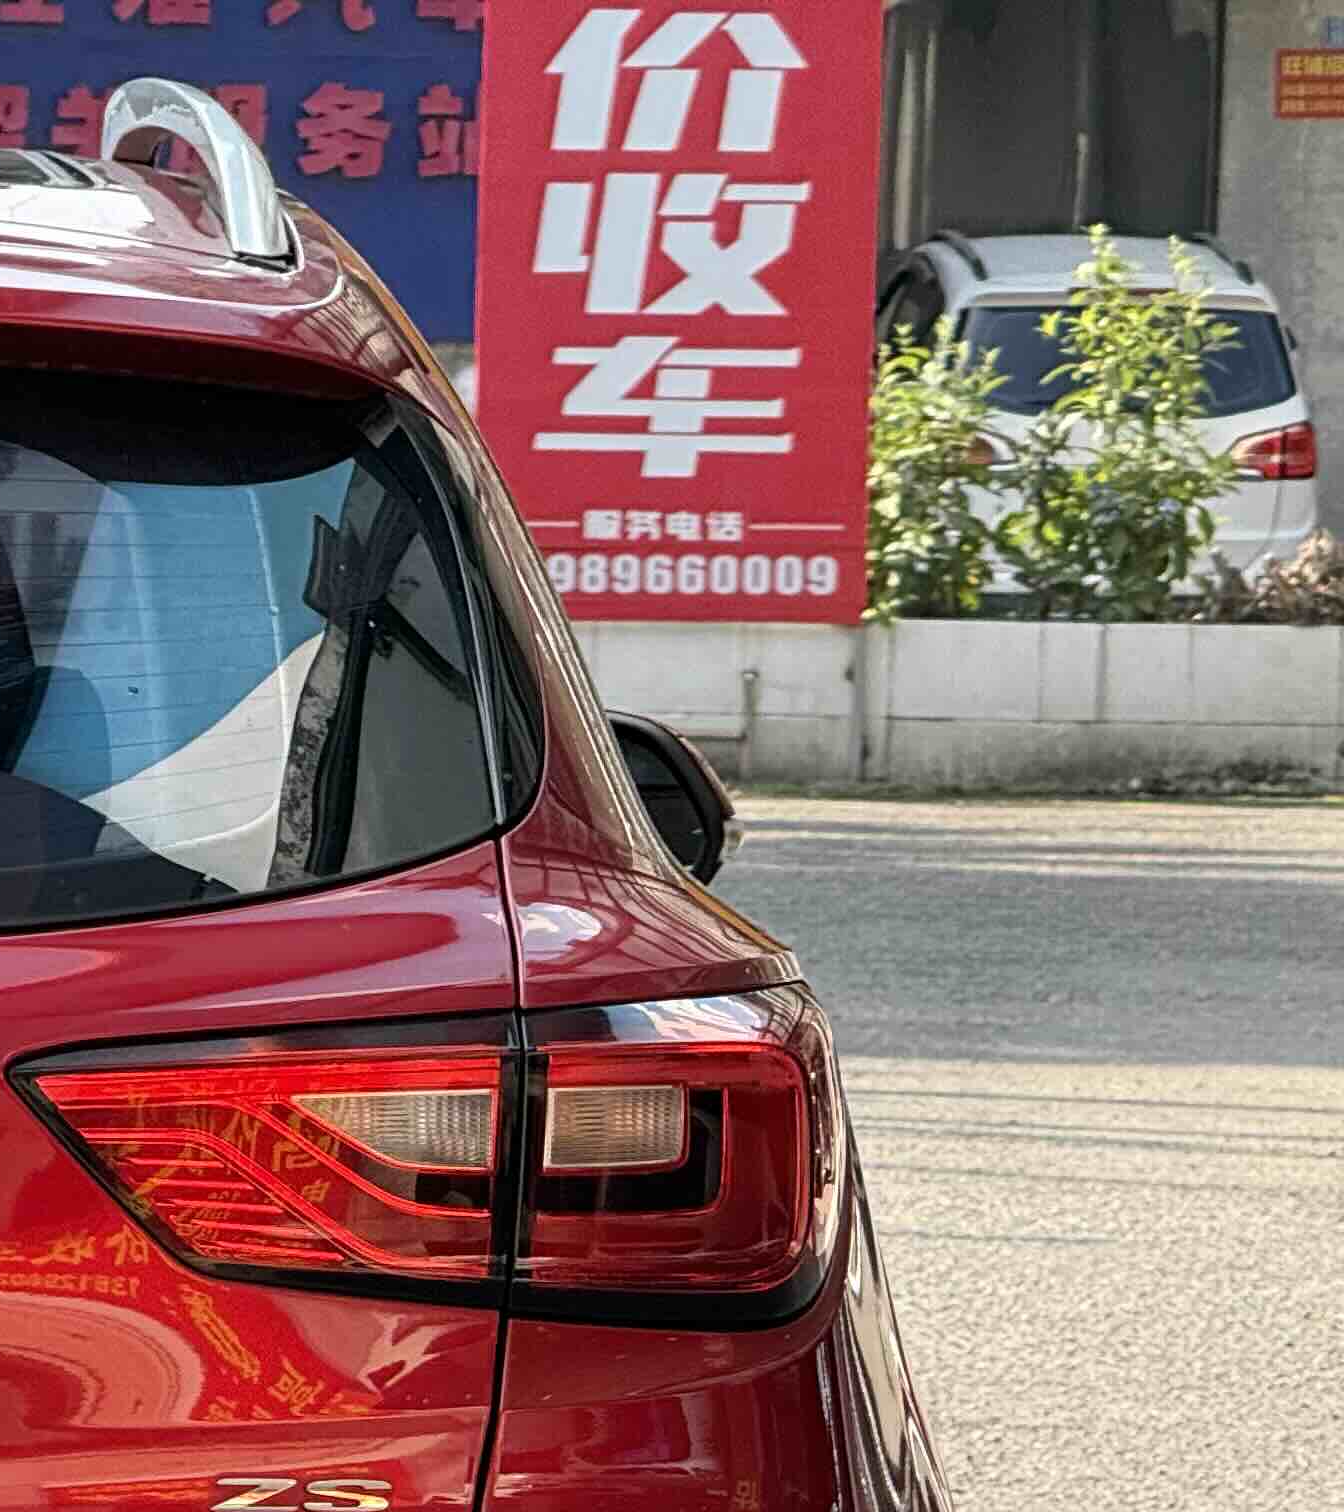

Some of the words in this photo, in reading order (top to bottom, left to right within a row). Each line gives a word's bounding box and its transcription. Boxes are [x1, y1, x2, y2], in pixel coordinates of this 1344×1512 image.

[532, 9, 812, 478] 价收车
[210, 1478, 392, 1512] ZS
